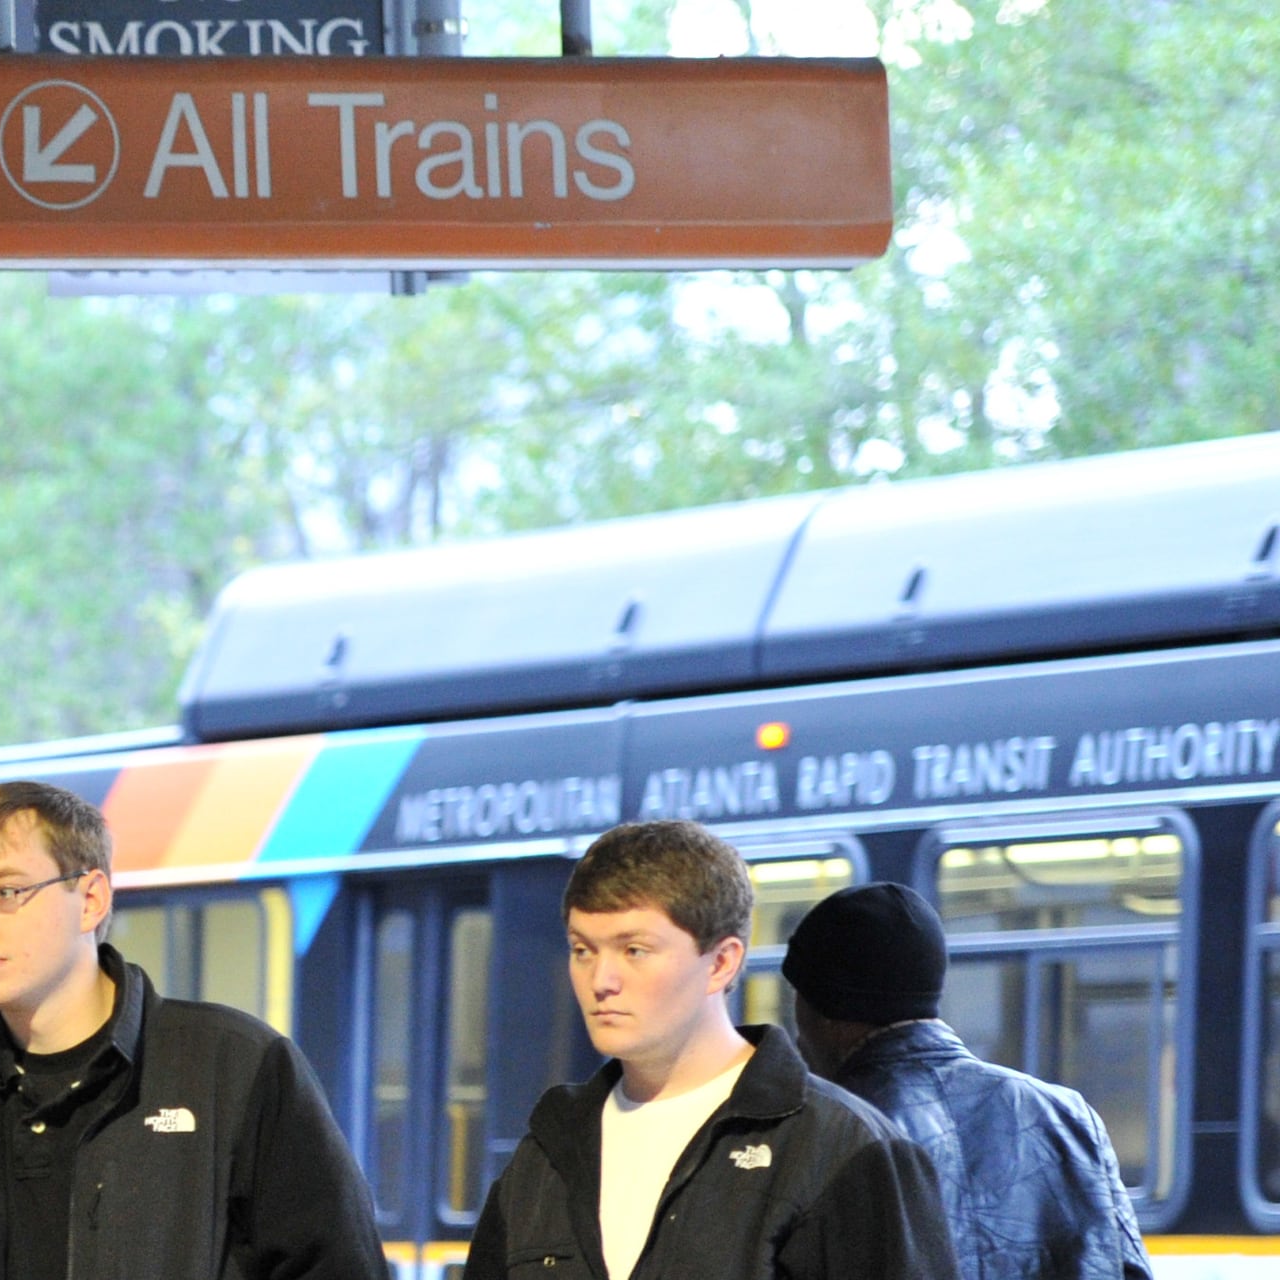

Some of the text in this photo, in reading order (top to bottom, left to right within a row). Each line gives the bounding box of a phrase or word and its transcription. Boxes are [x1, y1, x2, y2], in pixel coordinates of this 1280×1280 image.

[48, 18, 370, 56] SMOKING
[143, 92, 637, 201] All Trains
[396, 717, 1280, 843] METROPOLITAN ATLANTA RAPID TRANSIT AUTHORITY
